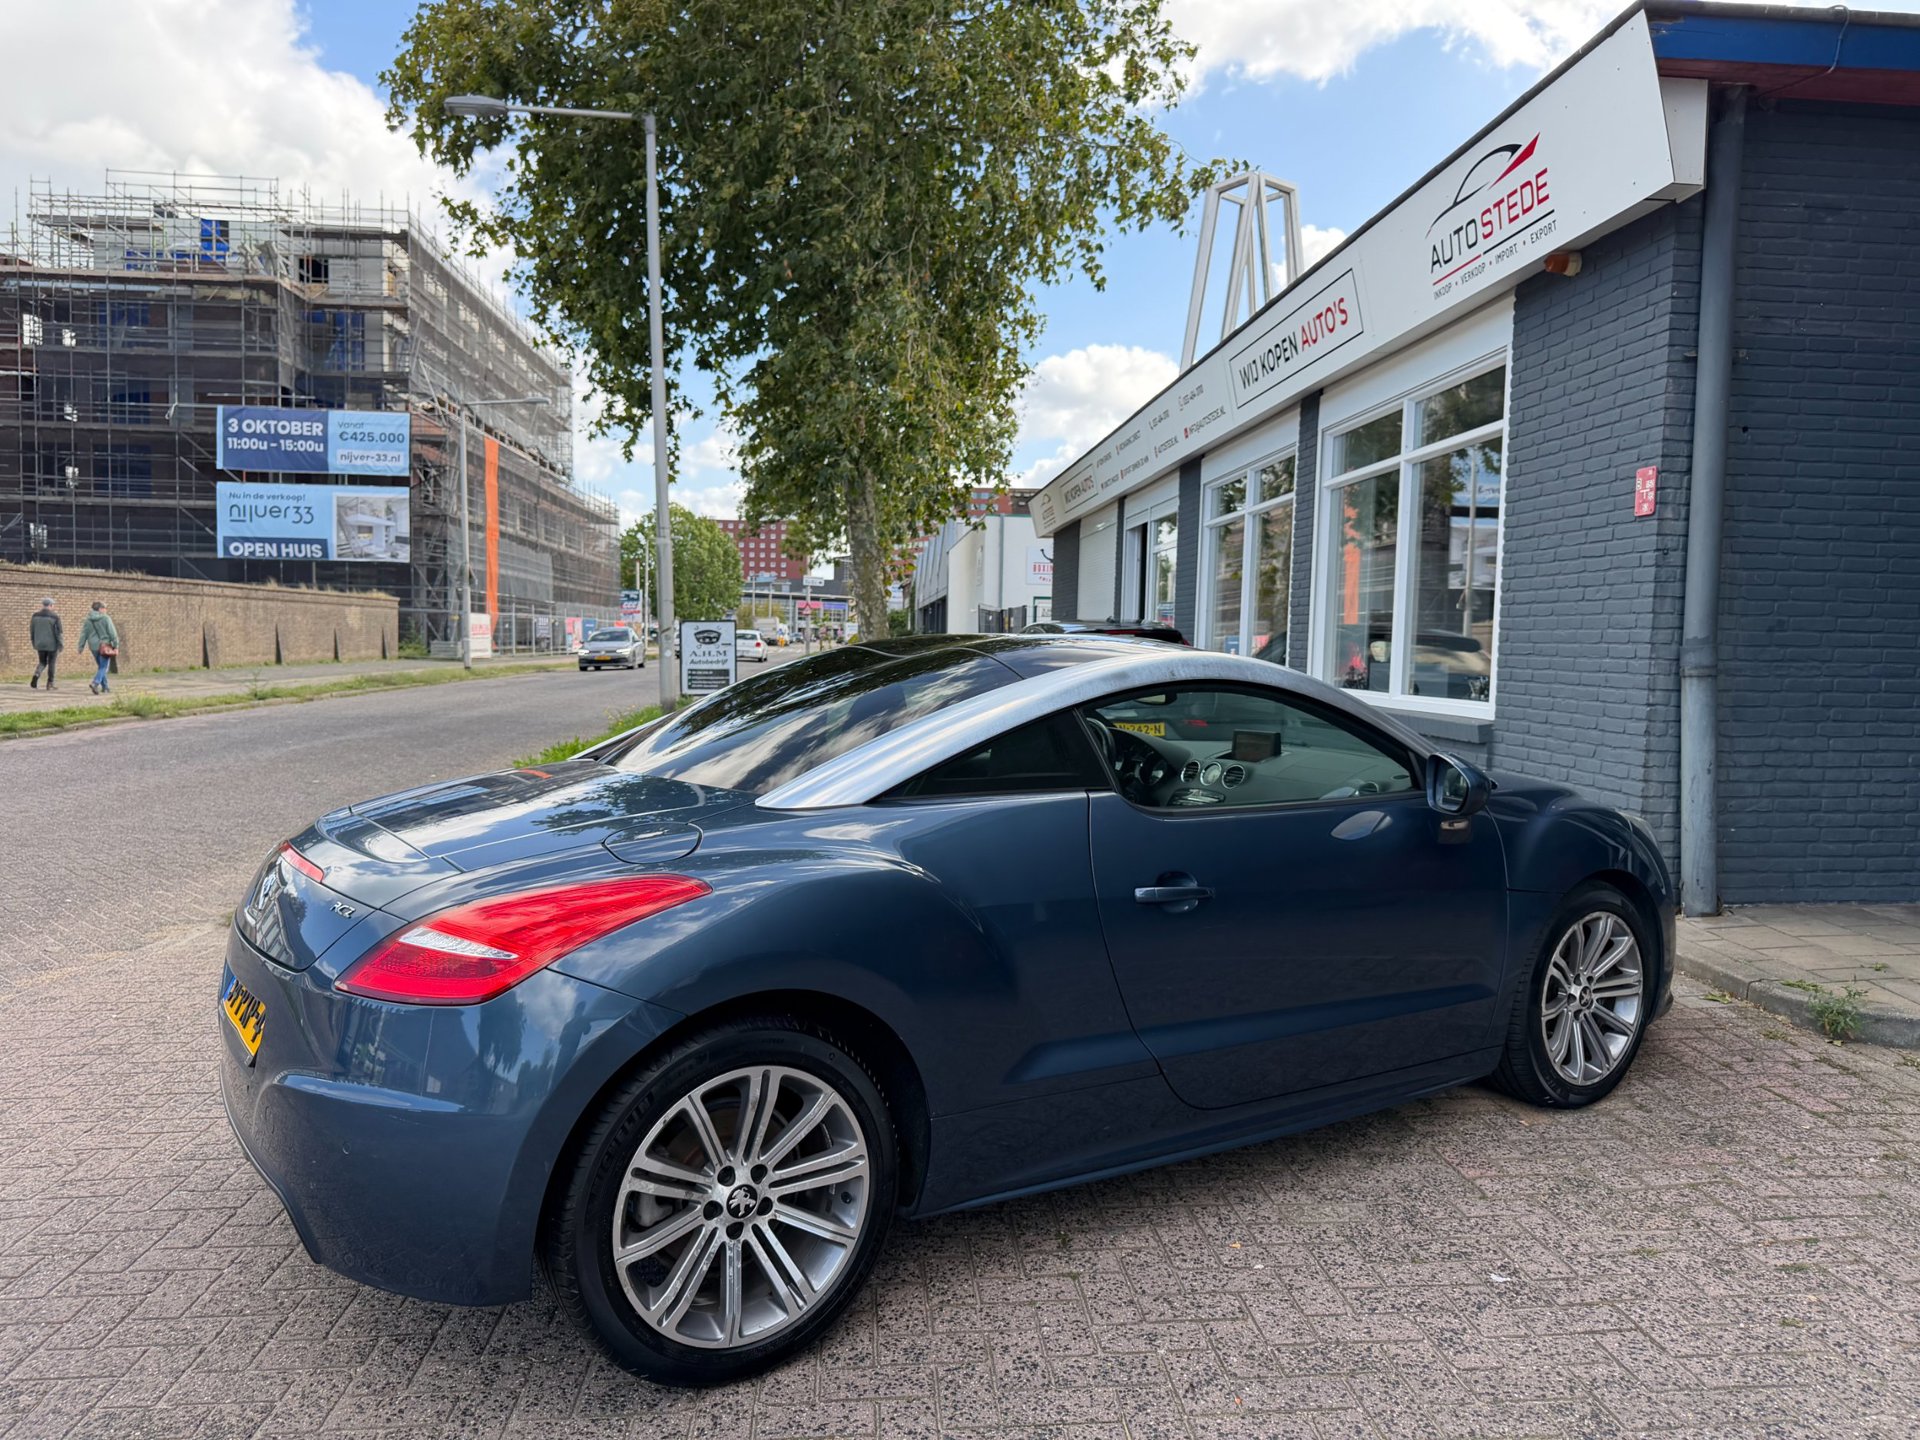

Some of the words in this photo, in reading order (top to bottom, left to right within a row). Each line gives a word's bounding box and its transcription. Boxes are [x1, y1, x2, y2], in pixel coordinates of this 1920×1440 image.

[1430, 167, 1550, 274] AUTOSTEDE
[1460, 262, 1486, 286] VERKOOP
[1494, 243, 1518, 263] IMPORT
[1530, 219, 1557, 245] EXPORT
[1238, 359, 1258, 390] WIJ
[1259, 331, 1299, 378] KOPEN
[1300, 297, 1348, 351] AUTO'S
[227, 418, 239, 433] 3
[242, 418, 323, 436] OKTOBER
[227, 437, 268, 450] 11:00u
[280, 439, 324, 453] 15:00u
[339, 431, 405, 444] €425.000
[340, 453, 401, 464] nijver-33.nl
[229, 492, 242, 500] Nu
[254, 492, 264, 500] de
[266, 493, 306, 502] verkoop!
[229, 542, 277, 557] OPEN
[281, 543, 323, 557] HUIS
[330, 901, 356, 919] RCZ
